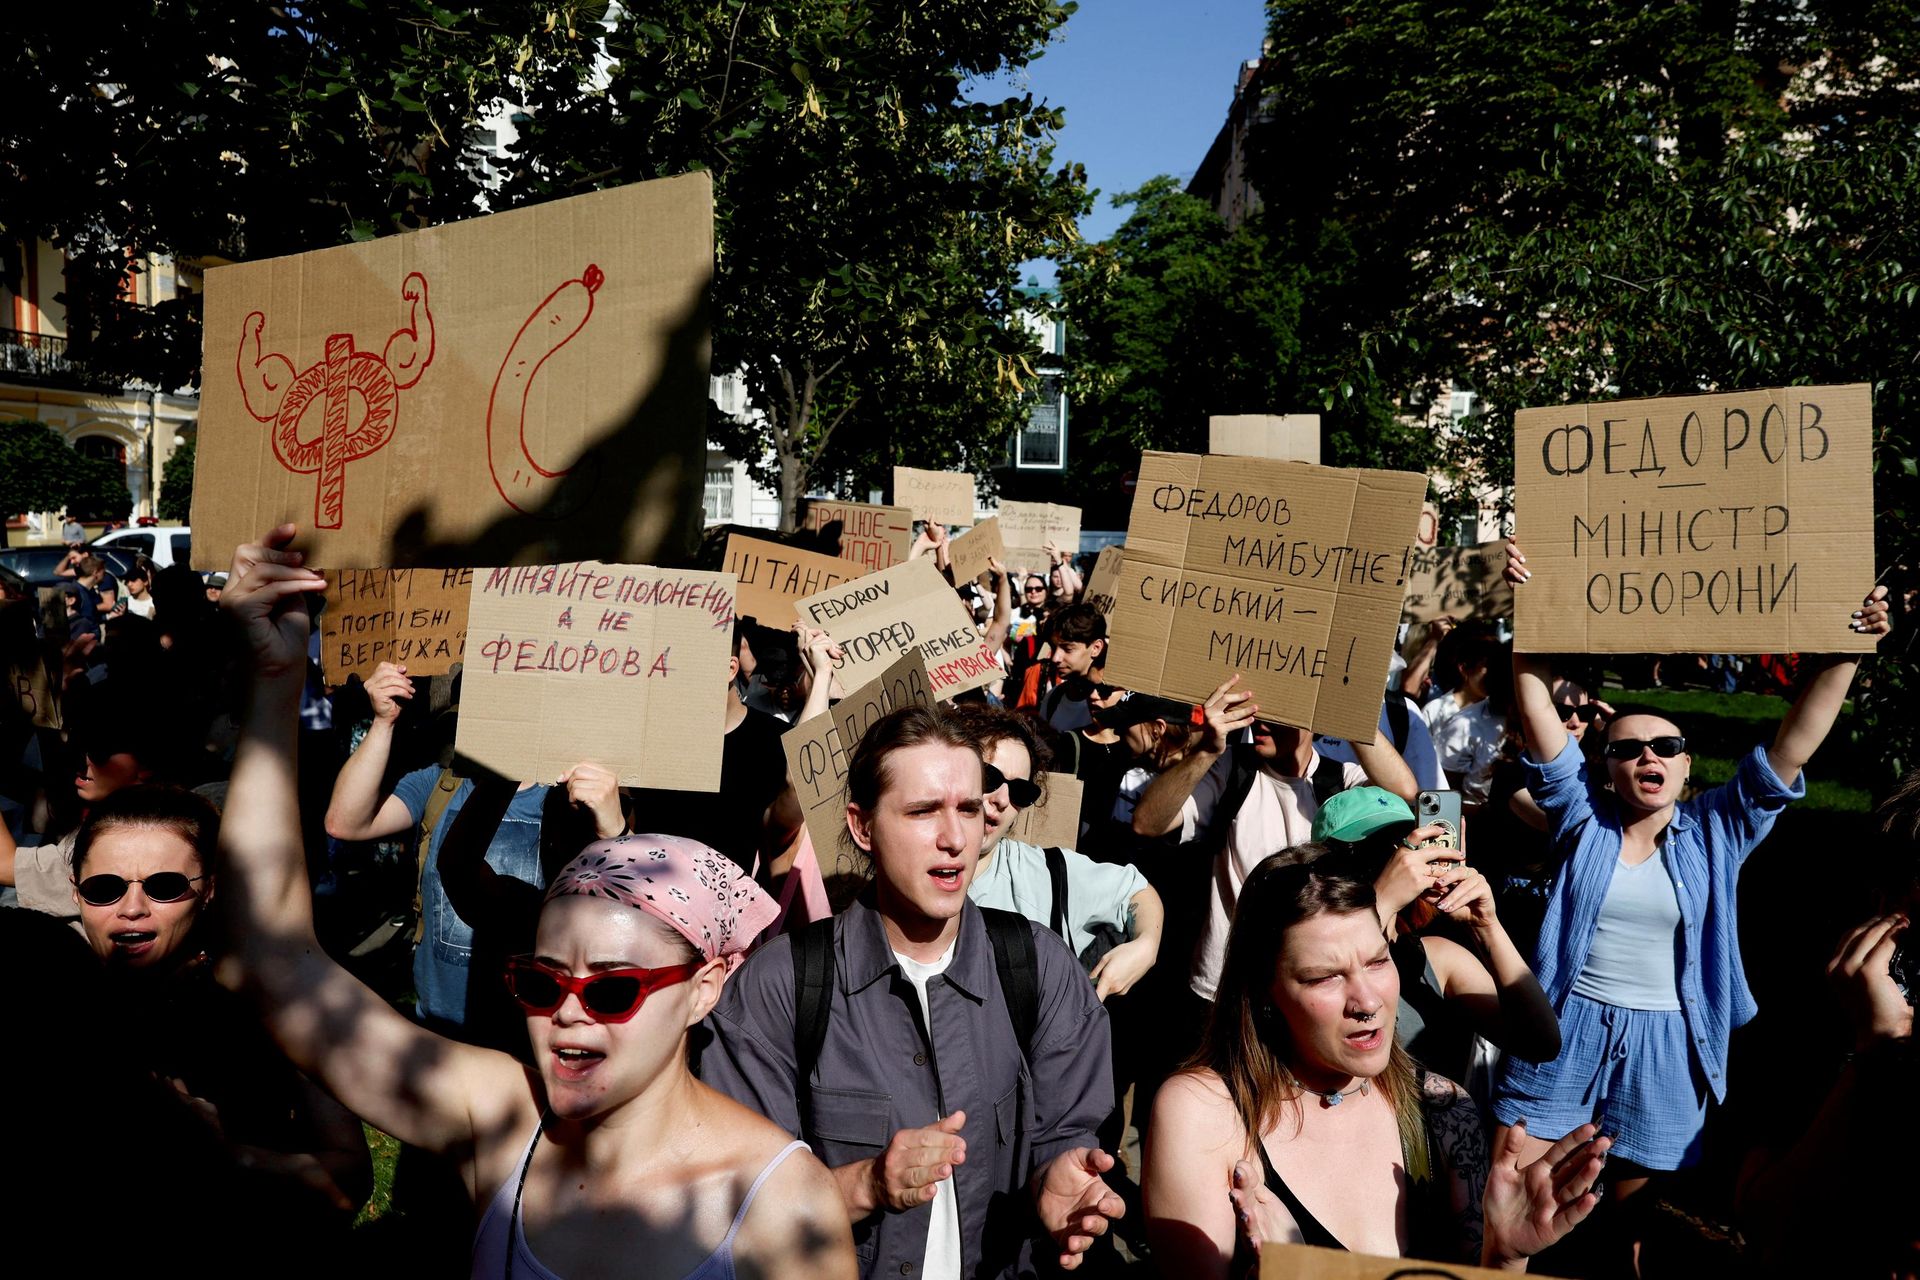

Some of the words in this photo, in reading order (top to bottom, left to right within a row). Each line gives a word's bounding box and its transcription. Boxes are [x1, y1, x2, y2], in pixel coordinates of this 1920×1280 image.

[1542, 401, 1830, 478] ФЕДОРОВ
[1153, 484, 1292, 526] ФЕДОРОВ
[731, 551, 859, 597] ШТАНГ
[1586, 563, 1799, 617] ОБОРОНИ
[558, 606, 573, 630] А
[598, 608, 634, 632] НЕ
[808, 580, 889, 624] FEDOROV
[1140, 576, 1285, 623] СИРСЬКИЙ
[481, 633, 677, 679] ФЕДОРОВА
[900, 627, 975, 661] SHEMES
